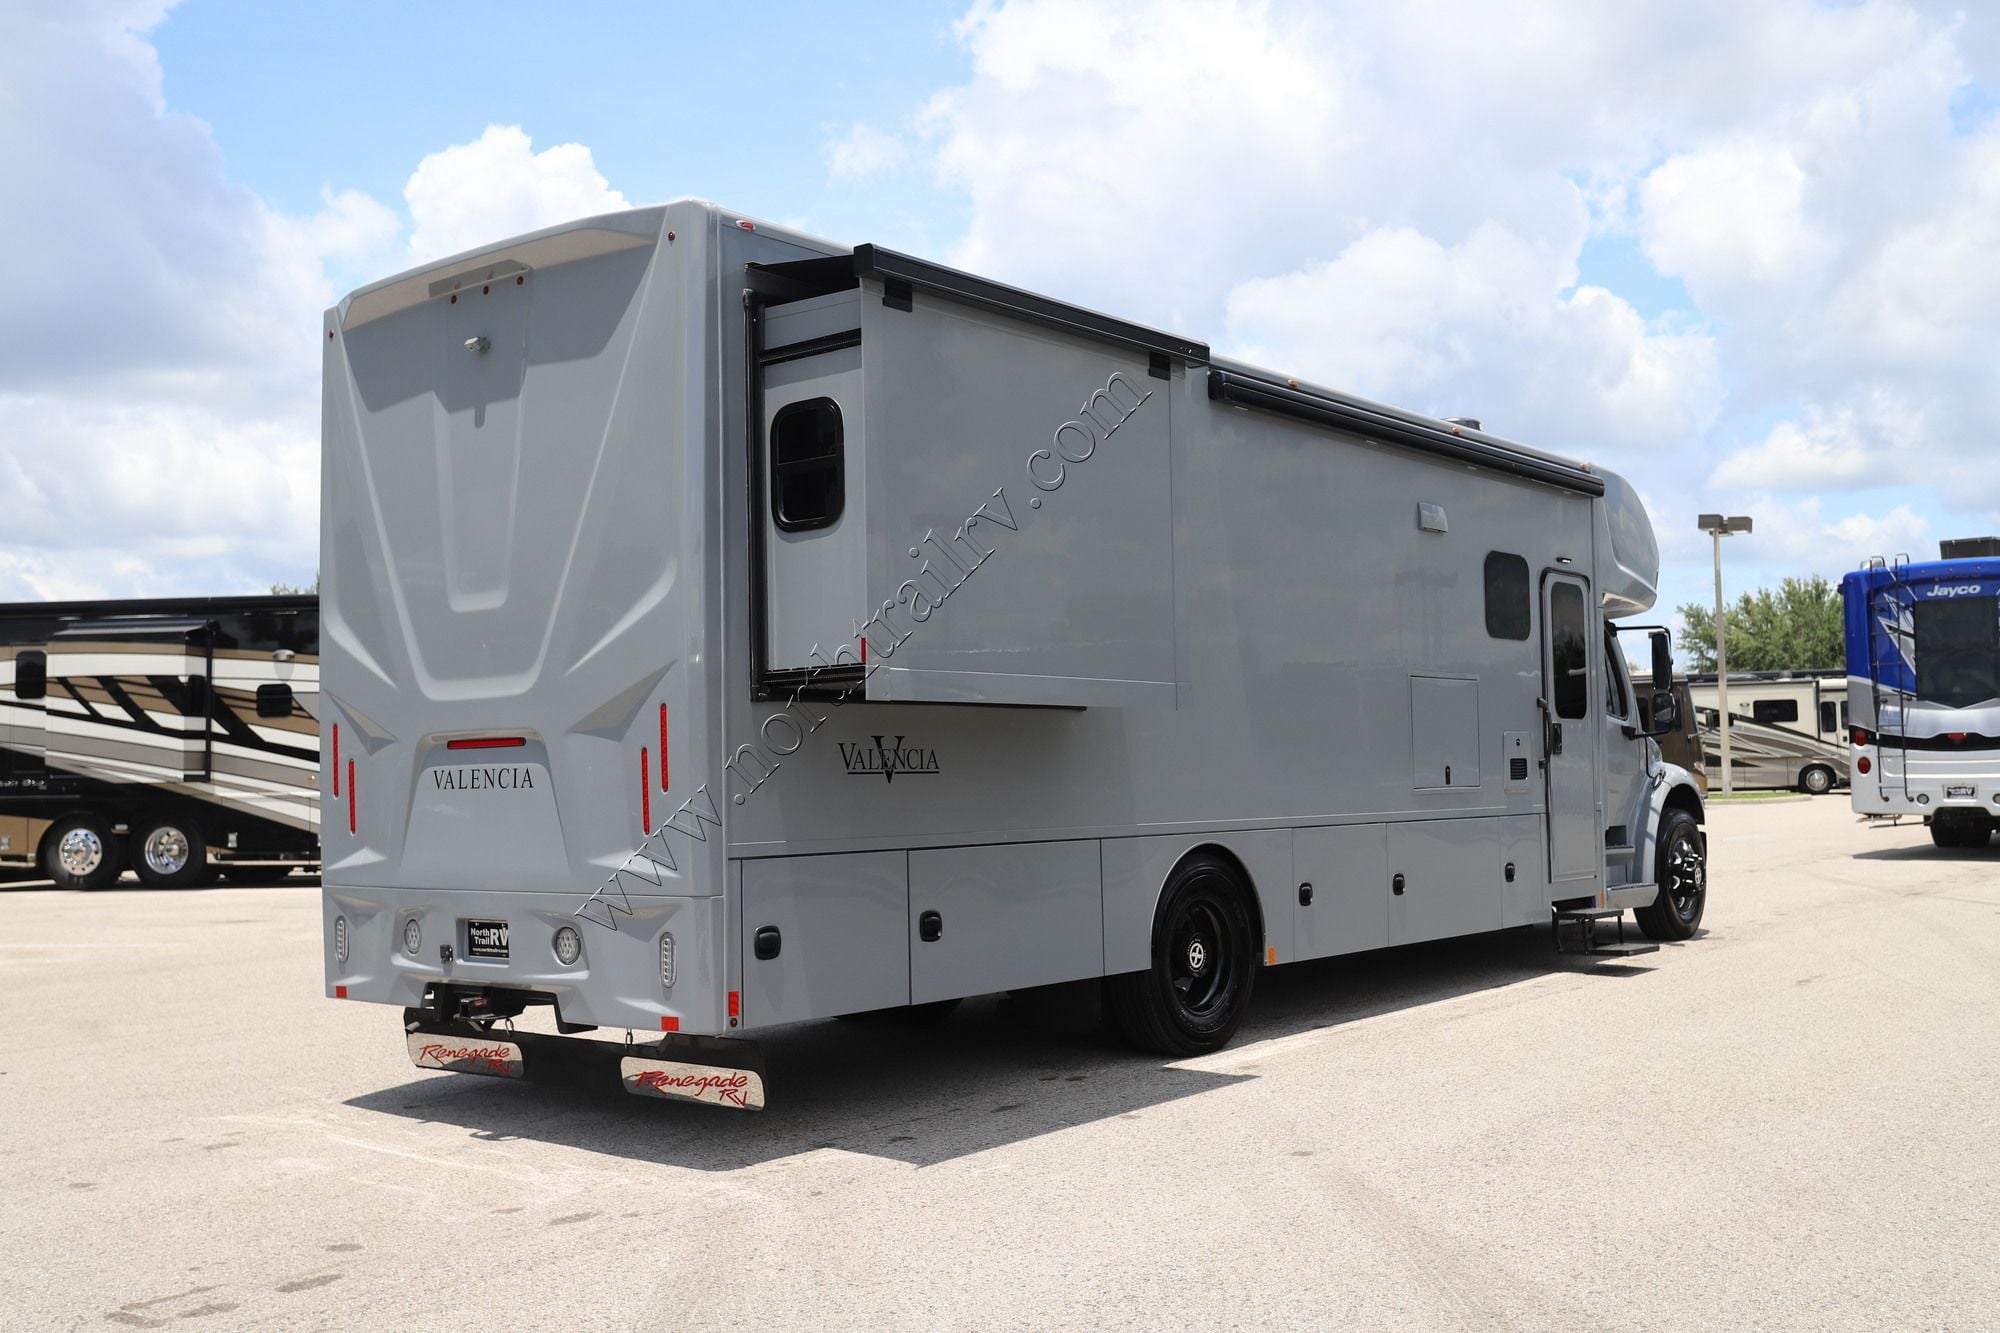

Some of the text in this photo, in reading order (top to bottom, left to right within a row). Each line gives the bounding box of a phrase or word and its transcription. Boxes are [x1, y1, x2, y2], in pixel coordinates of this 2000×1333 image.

[1926, 584, 1981, 598] Jayco
[837, 739, 940, 777] VALENCIA
[433, 767, 534, 790] VALENCIA
[470, 927, 490, 937] North
[473, 936, 490, 945] Trail
[490, 928, 509, 946] RV
[419, 1044, 510, 1067] Renegade
[634, 1071, 747, 1096] Renegade
[719, 1088, 747, 1106] RV
